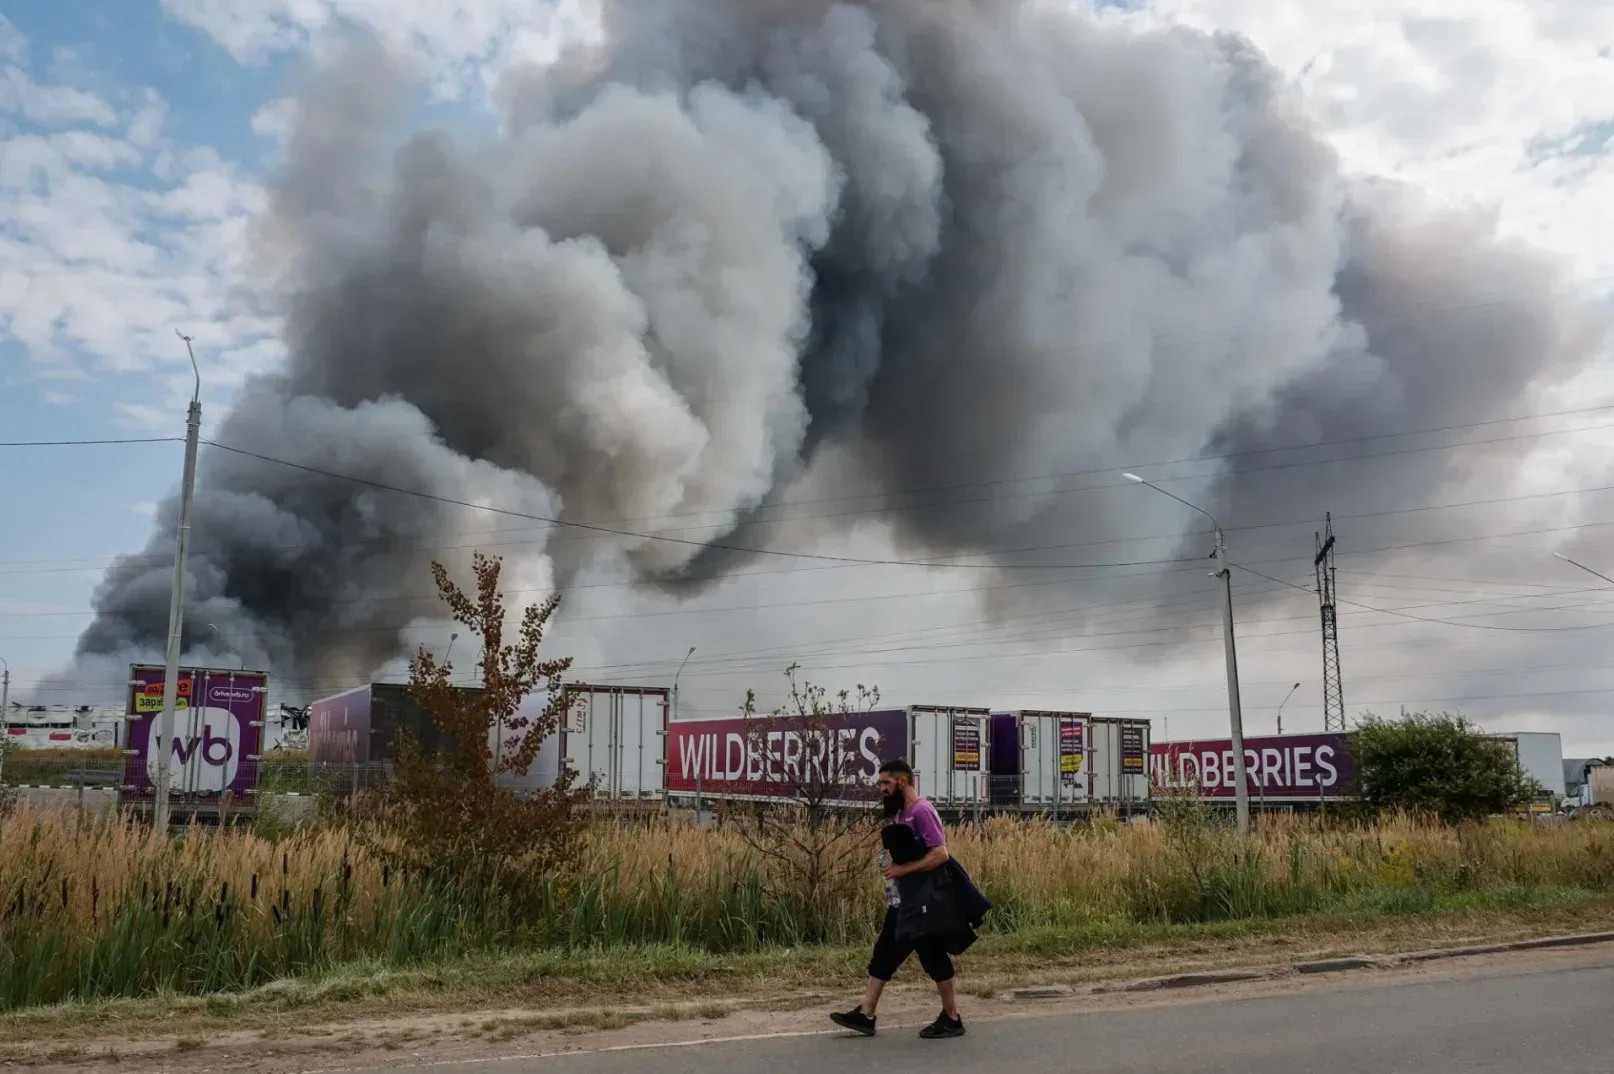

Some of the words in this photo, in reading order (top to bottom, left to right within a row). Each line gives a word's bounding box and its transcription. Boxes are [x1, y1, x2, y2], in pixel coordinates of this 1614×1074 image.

[214, 689, 249, 698] drivewb.ru
[155, 724, 233, 767] wb
[679, 727, 880, 786] WILDBERRIES
